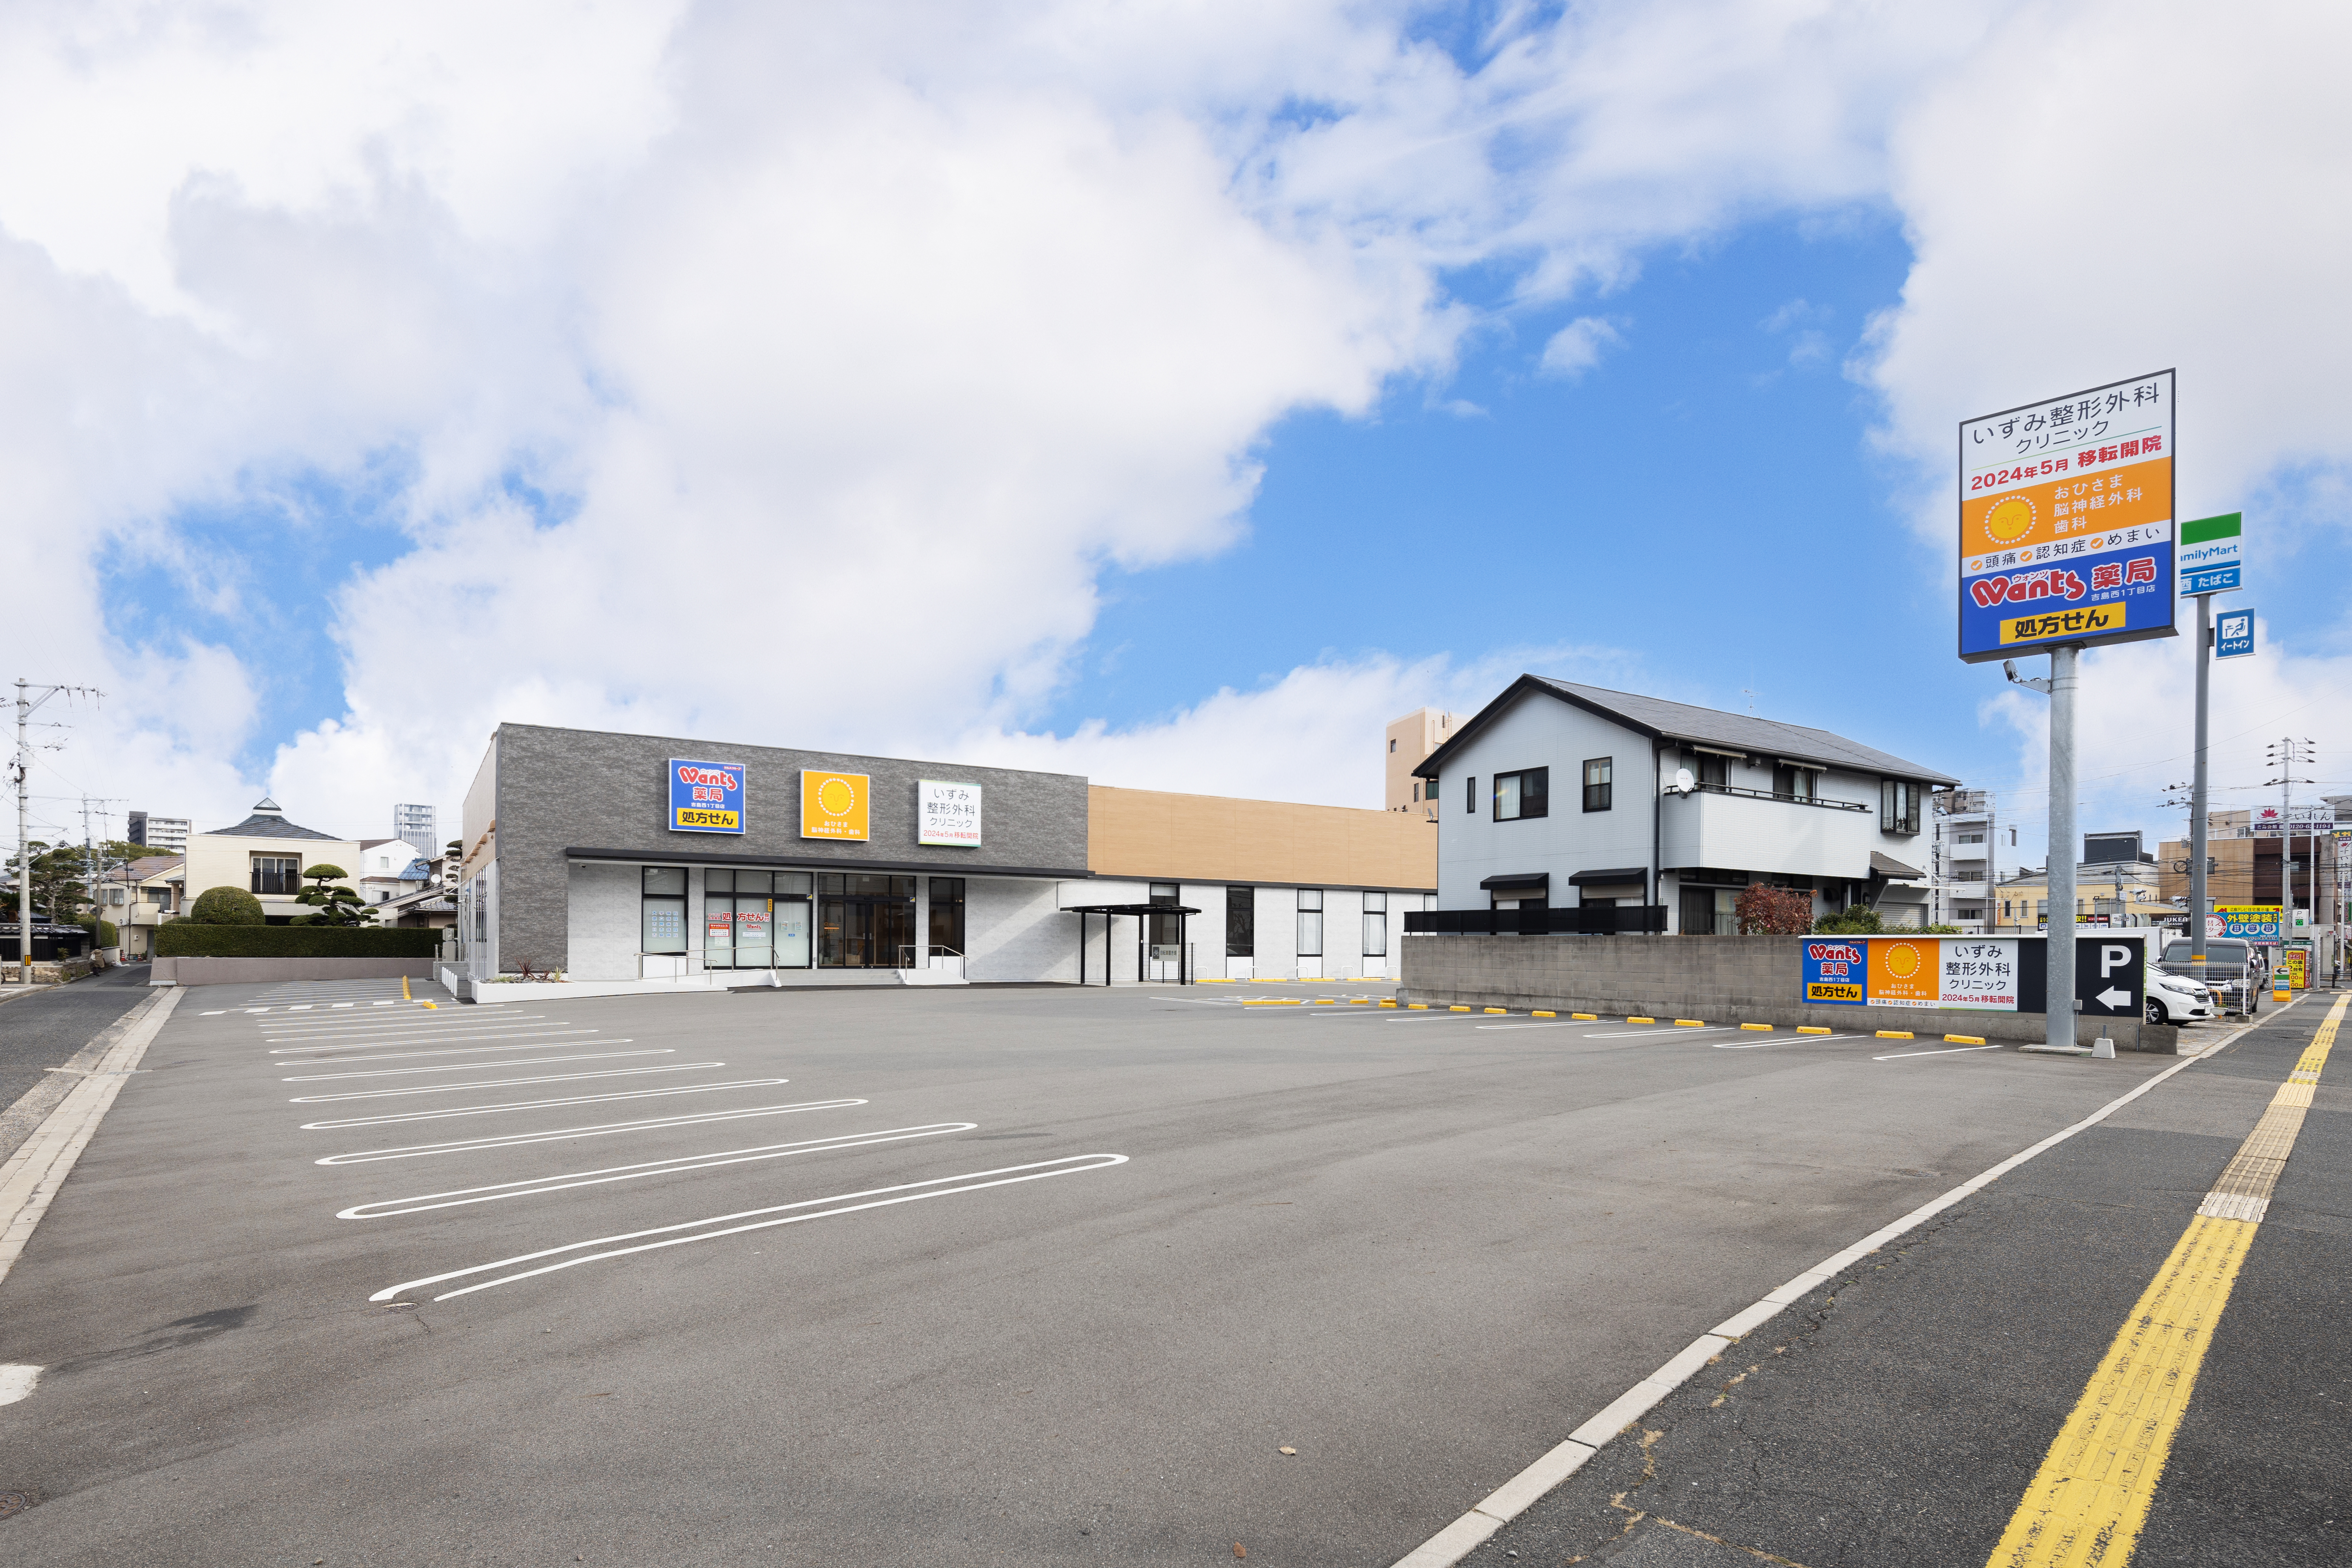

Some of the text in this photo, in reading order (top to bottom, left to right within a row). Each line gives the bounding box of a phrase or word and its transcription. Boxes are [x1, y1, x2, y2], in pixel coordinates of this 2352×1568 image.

[1973, 382, 2159, 444] いずみ整形外科
[2016, 420, 2109, 454] クリニック
[1971, 435, 2162, 490] 2024年5月 移転開院
[2054, 474, 2123, 500] おひさま
[2054, 487, 2143, 517] 脳神経外科
[2054, 516, 2087, 534] 歯科
[1985, 528, 2160, 569] 頭痛 認知症 めまい
[2013, 571, 2048, 583] ウォンツ
[2092, 557, 2157, 591] 薬局
[2198, 573, 2233, 587] たばこ
[1971, 569, 2086, 607] Wants
[2091, 585, 2155, 601] 吉島西1丁目店
[2015, 609, 2109, 639] 処方せん
[2221, 640, 2249, 651] イートイン
[678, 767, 737, 790] Wants
[693, 787, 723, 802] 薬局
[934, 789, 969, 800] いずみ
[927, 802, 975, 816] 整形外科
[682, 811, 733, 825] 処方せん
[930, 817, 972, 827] クリニック
[2226, 913, 2272, 923] 外壁塗装
[1808, 944, 1861, 964] Wants
[1955, 944, 2002, 958] いずみ
[1821, 962, 1848, 975] 薬局
[1946, 962, 2011, 976] 整形外科
[2101, 945, 2132, 978] P
[1811, 986, 1857, 998] 処方せん
[1949, 979, 2006, 990] クリニック
[1942, 994, 2014, 1004] 2024年5月 移転開院
